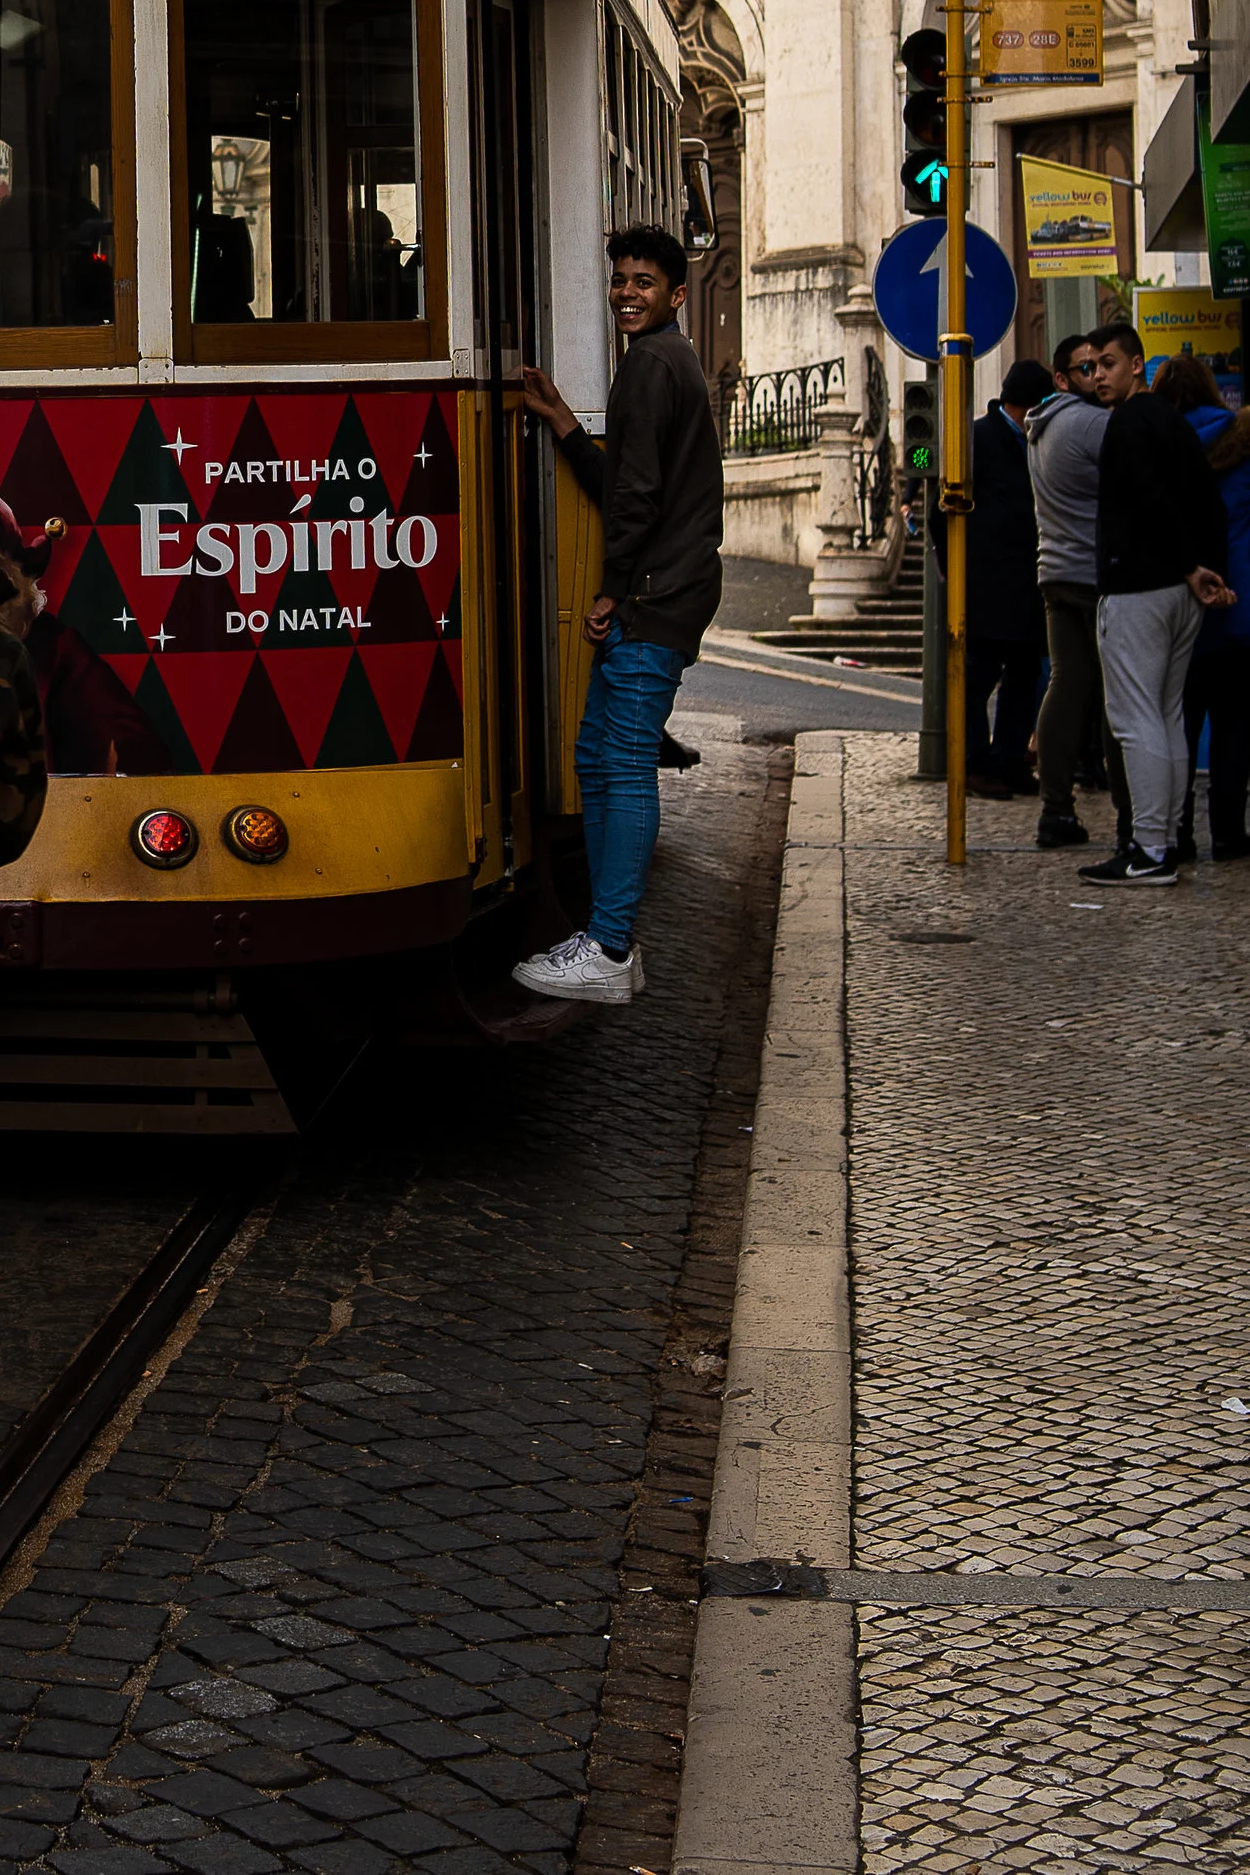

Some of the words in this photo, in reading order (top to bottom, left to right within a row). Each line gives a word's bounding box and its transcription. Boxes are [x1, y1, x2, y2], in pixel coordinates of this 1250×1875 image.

[997, 34, 1021, 46] 737
[1033, 33, 1057, 45] 28E
[1069, 58, 1095, 69] 3599
[204, 458, 350, 484] PARTILHA
[357, 458, 377, 480] O
[134, 493, 438, 594] Espírito
[226, 609, 269, 633] DO
[279, 606, 372, 632] NATAL
